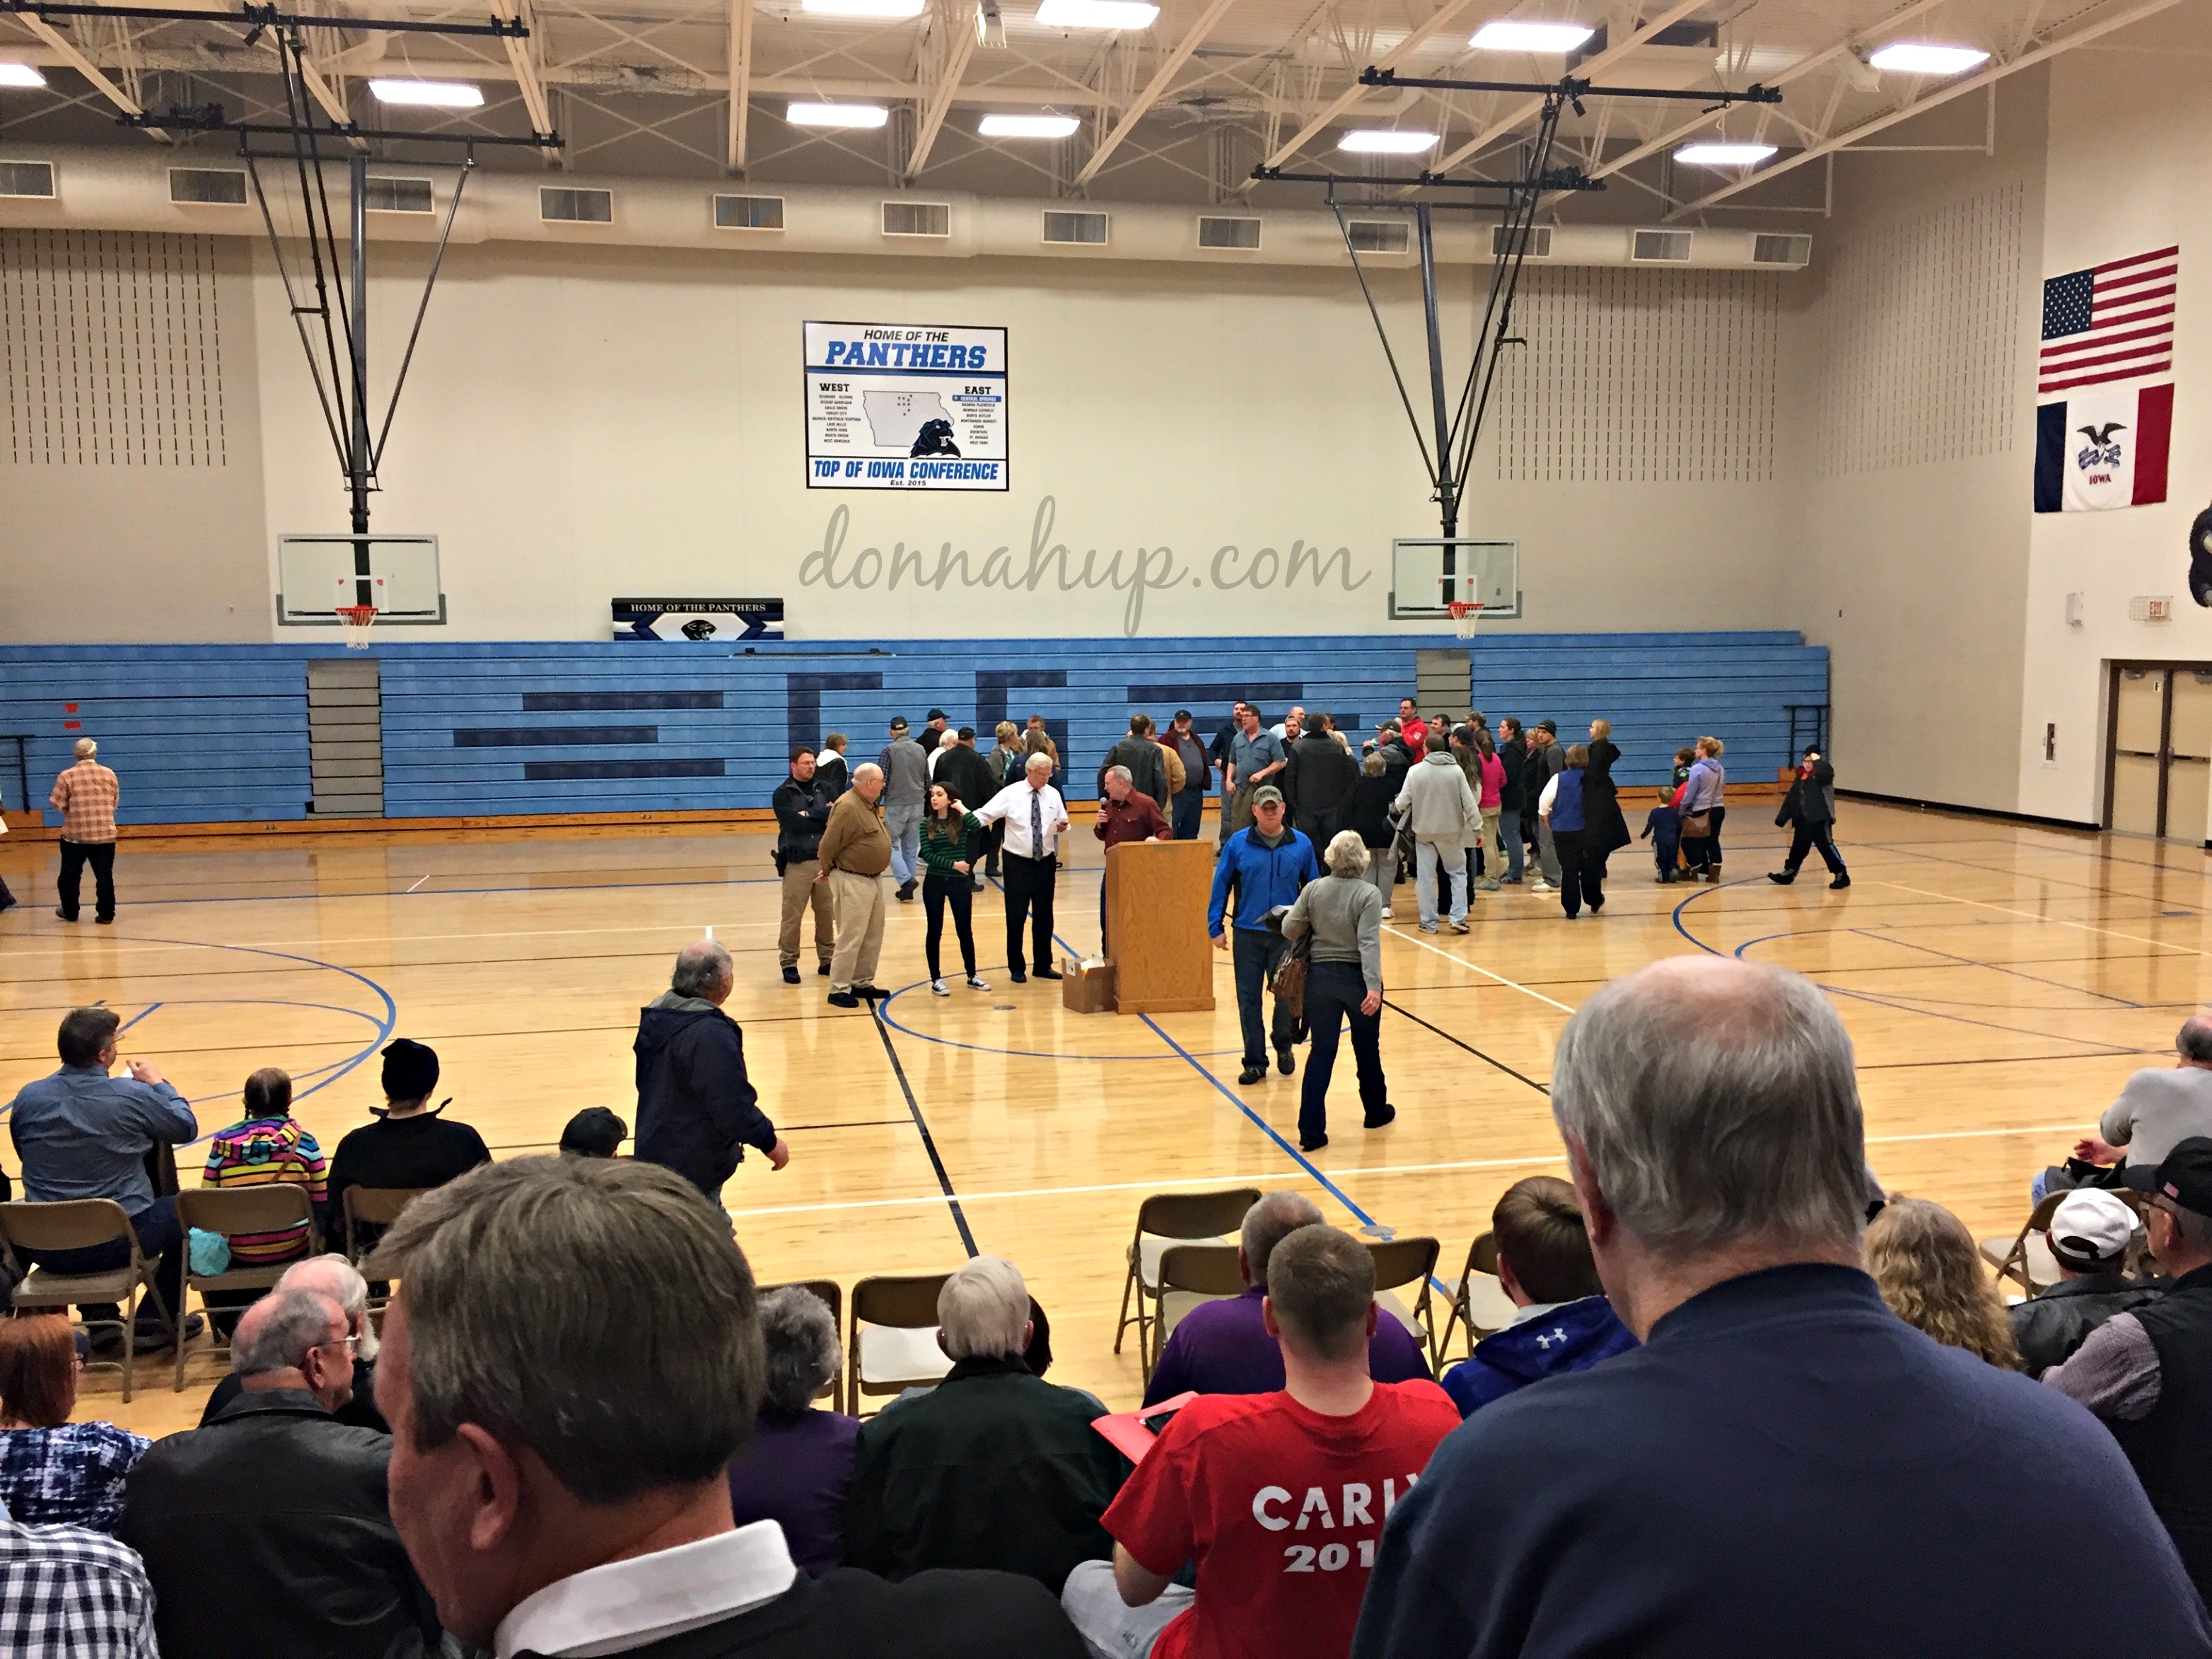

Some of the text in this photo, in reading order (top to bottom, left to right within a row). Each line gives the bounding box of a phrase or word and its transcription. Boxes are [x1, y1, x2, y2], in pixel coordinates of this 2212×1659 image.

[863, 329, 949, 342] HOME OF THE
[825, 340, 987, 369] PANTHERS
[819, 383, 850, 392] WEST
[965, 385, 991, 395] EAST
[814, 460, 999, 480] TOP OF IOWA CONFERENCE
[2088, 473, 2112, 485] IOWA
[1252, 1472, 1419, 1532] CARL
[1282, 1539, 1375, 1573] 201
